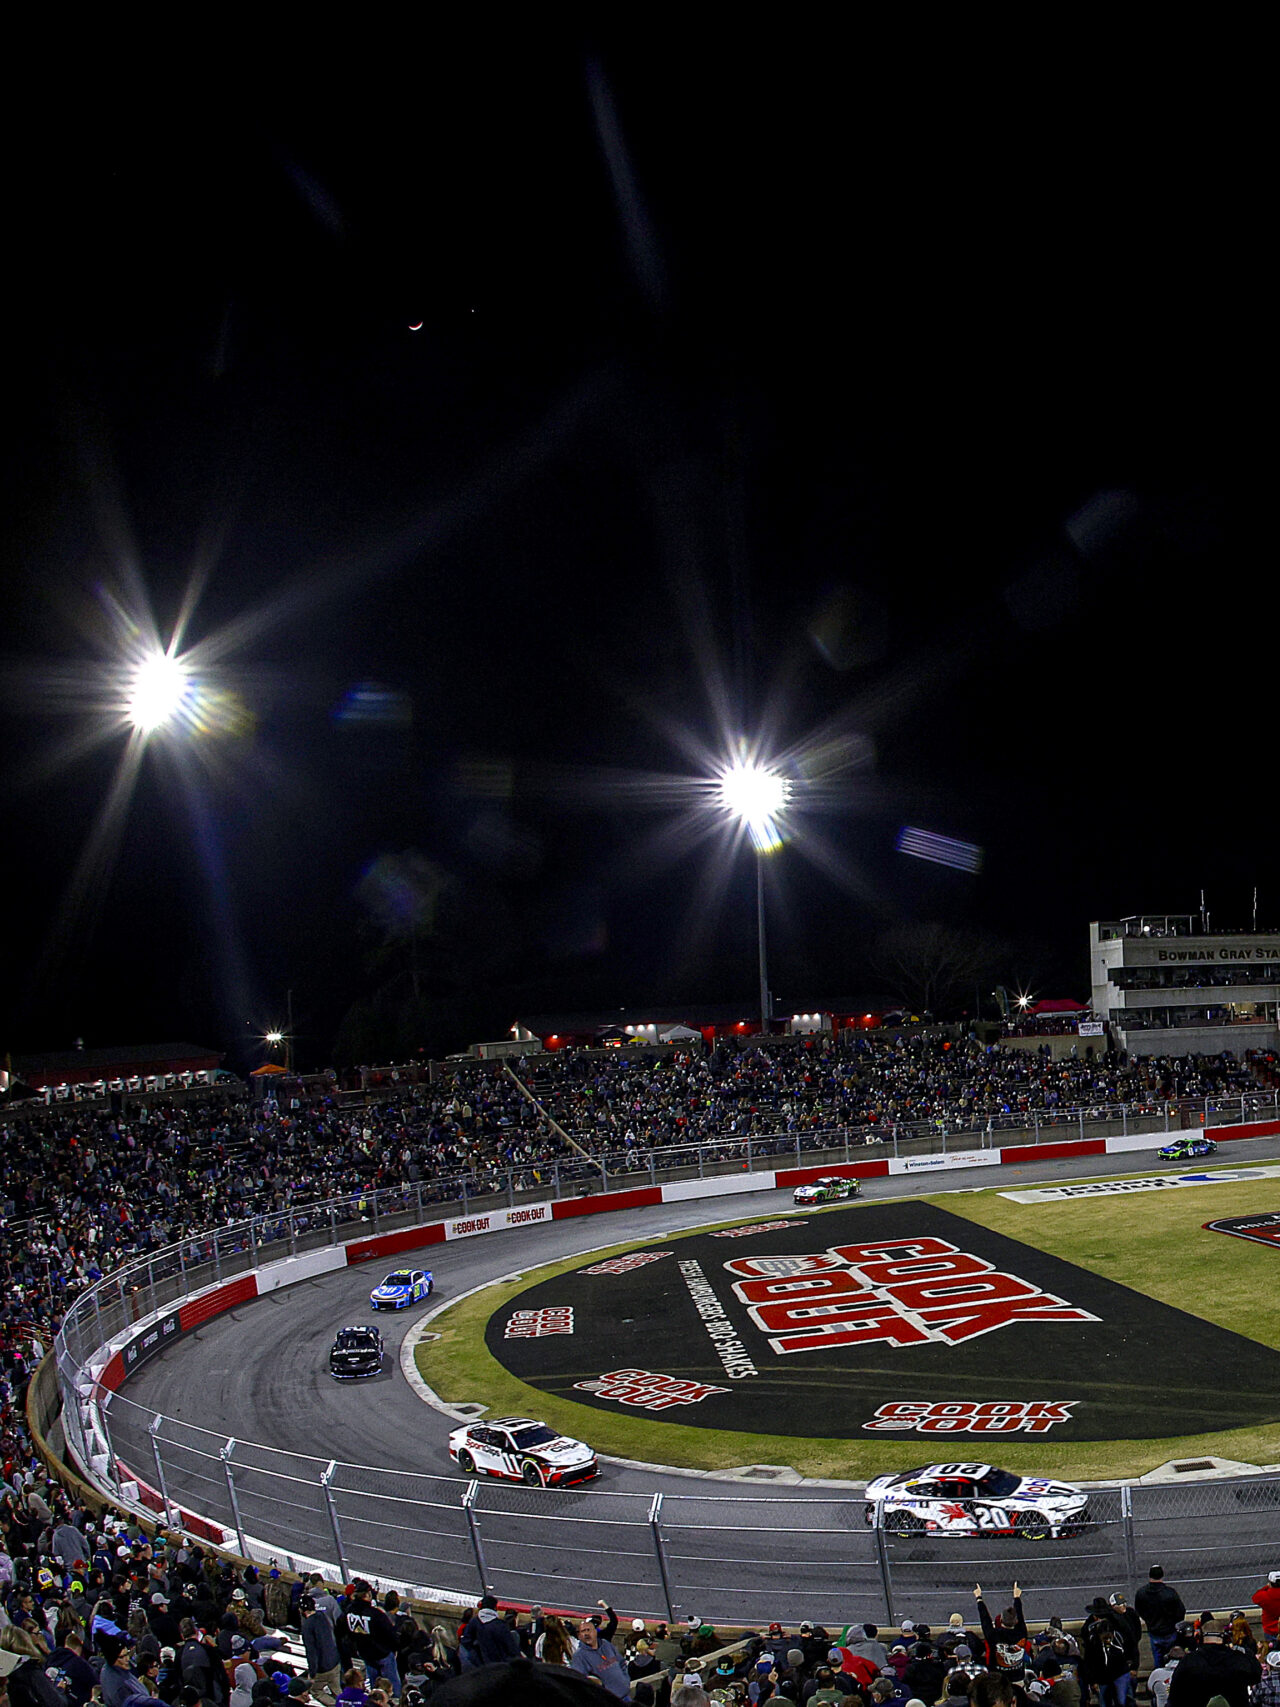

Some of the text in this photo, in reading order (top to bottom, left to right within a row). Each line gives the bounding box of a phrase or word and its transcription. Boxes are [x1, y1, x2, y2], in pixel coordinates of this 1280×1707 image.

[1159, 950, 1214, 961] BOWMAN
[1219, 949, 1252, 959] GRAY
[457, 1217, 490, 1234] COOK OUT
[511, 1207, 546, 1224] COOK OUT
[826, 1237, 1104, 1346] COOK
[538, 1306, 574, 1337] COOK
[678, 1259, 759, 1379] FRESH HAMBURGERS BBQ SHAKES
[731, 1270, 942, 1354] OUT
[504, 1316, 539, 1339] OUT
[600, 1368, 734, 1401] COOK
[594, 1385, 695, 1411] OUT
[873, 1400, 1082, 1418] COOK
[916, 1416, 1070, 1433] OUT
[528, 1436, 568, 1453] Sport
[550, 1441, 581, 1453] Clips
[501, 1452, 521, 1473] 11
[940, 1464, 984, 1475] 20
[976, 1507, 1011, 1530] 20
[346, 1612, 371, 1635] CAT
